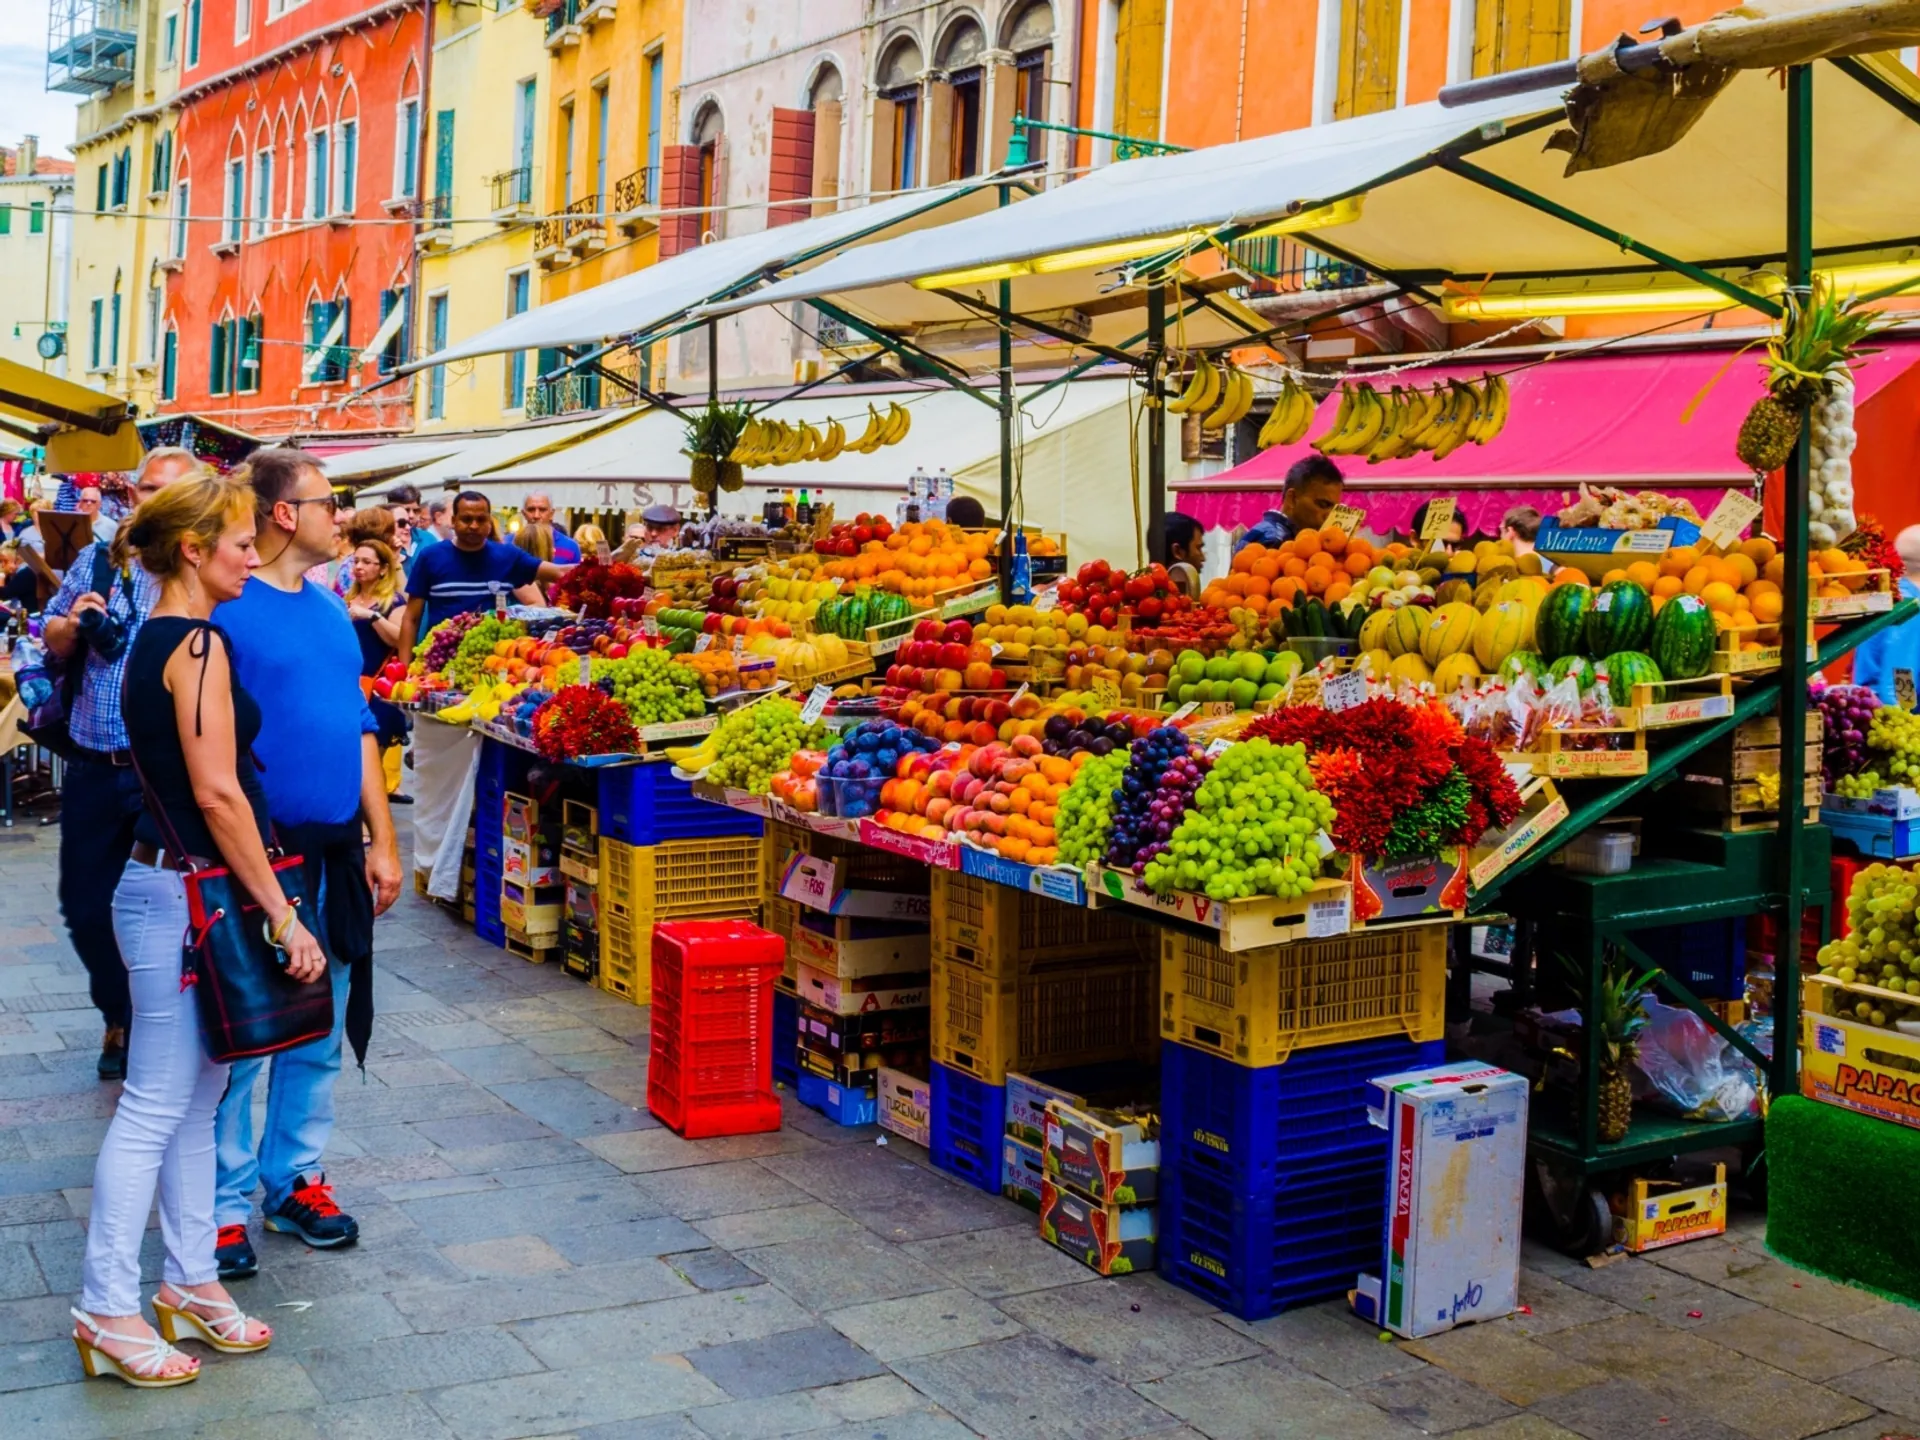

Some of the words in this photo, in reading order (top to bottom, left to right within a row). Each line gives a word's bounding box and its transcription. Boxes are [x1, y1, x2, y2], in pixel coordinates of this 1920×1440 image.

[1540, 530, 1608, 551] Marlene
[1504, 827, 1536, 855] OROGEL
[808, 877, 826, 897] FOSI
[906, 898, 930, 915] FOS
[890, 991, 923, 1006] Actel
[1398, 1148, 1412, 1216] VIGNOLA
[1652, 1210, 1712, 1241] PAPAGNI
